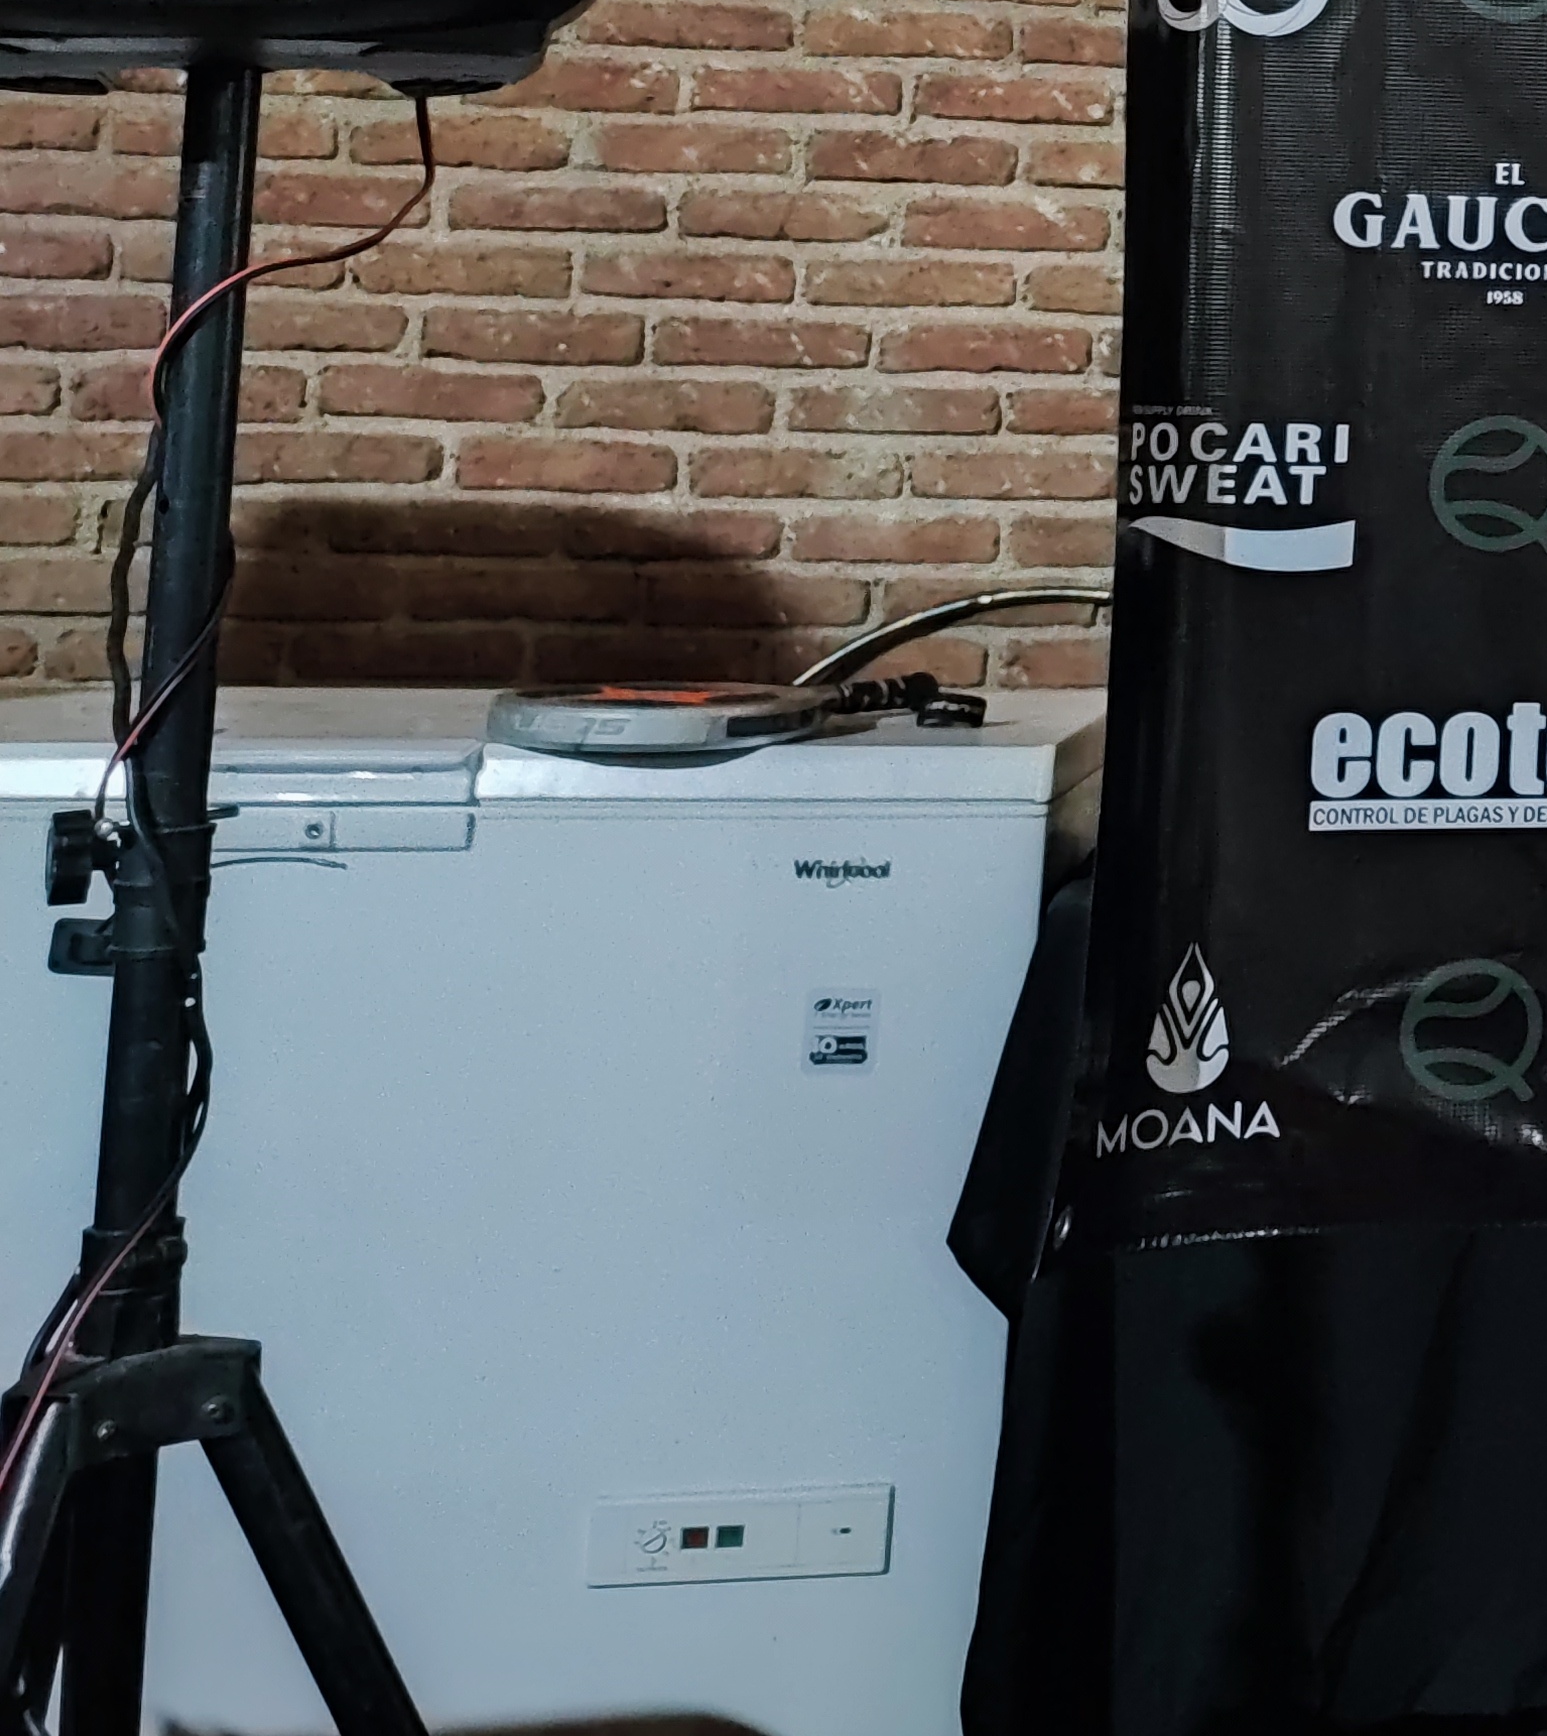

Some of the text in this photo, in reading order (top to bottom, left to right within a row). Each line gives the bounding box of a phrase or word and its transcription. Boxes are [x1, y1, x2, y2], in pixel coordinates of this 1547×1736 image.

[1495, 162, 1525, 186] EL
[1486, 290, 1524, 306] 1958
[1130, 422, 1350, 464] POCARI
[1129, 464, 1327, 506] SWEAT
[1313, 807, 1399, 826] CONTROL
[1404, 807, 1427, 824] DE
[1433, 806, 1504, 824] PLAGAS
[1508, 806, 1518, 823] Y
[833, 998, 873, 1014] Xpert
[1096, 1100, 1281, 1158] MOANA
